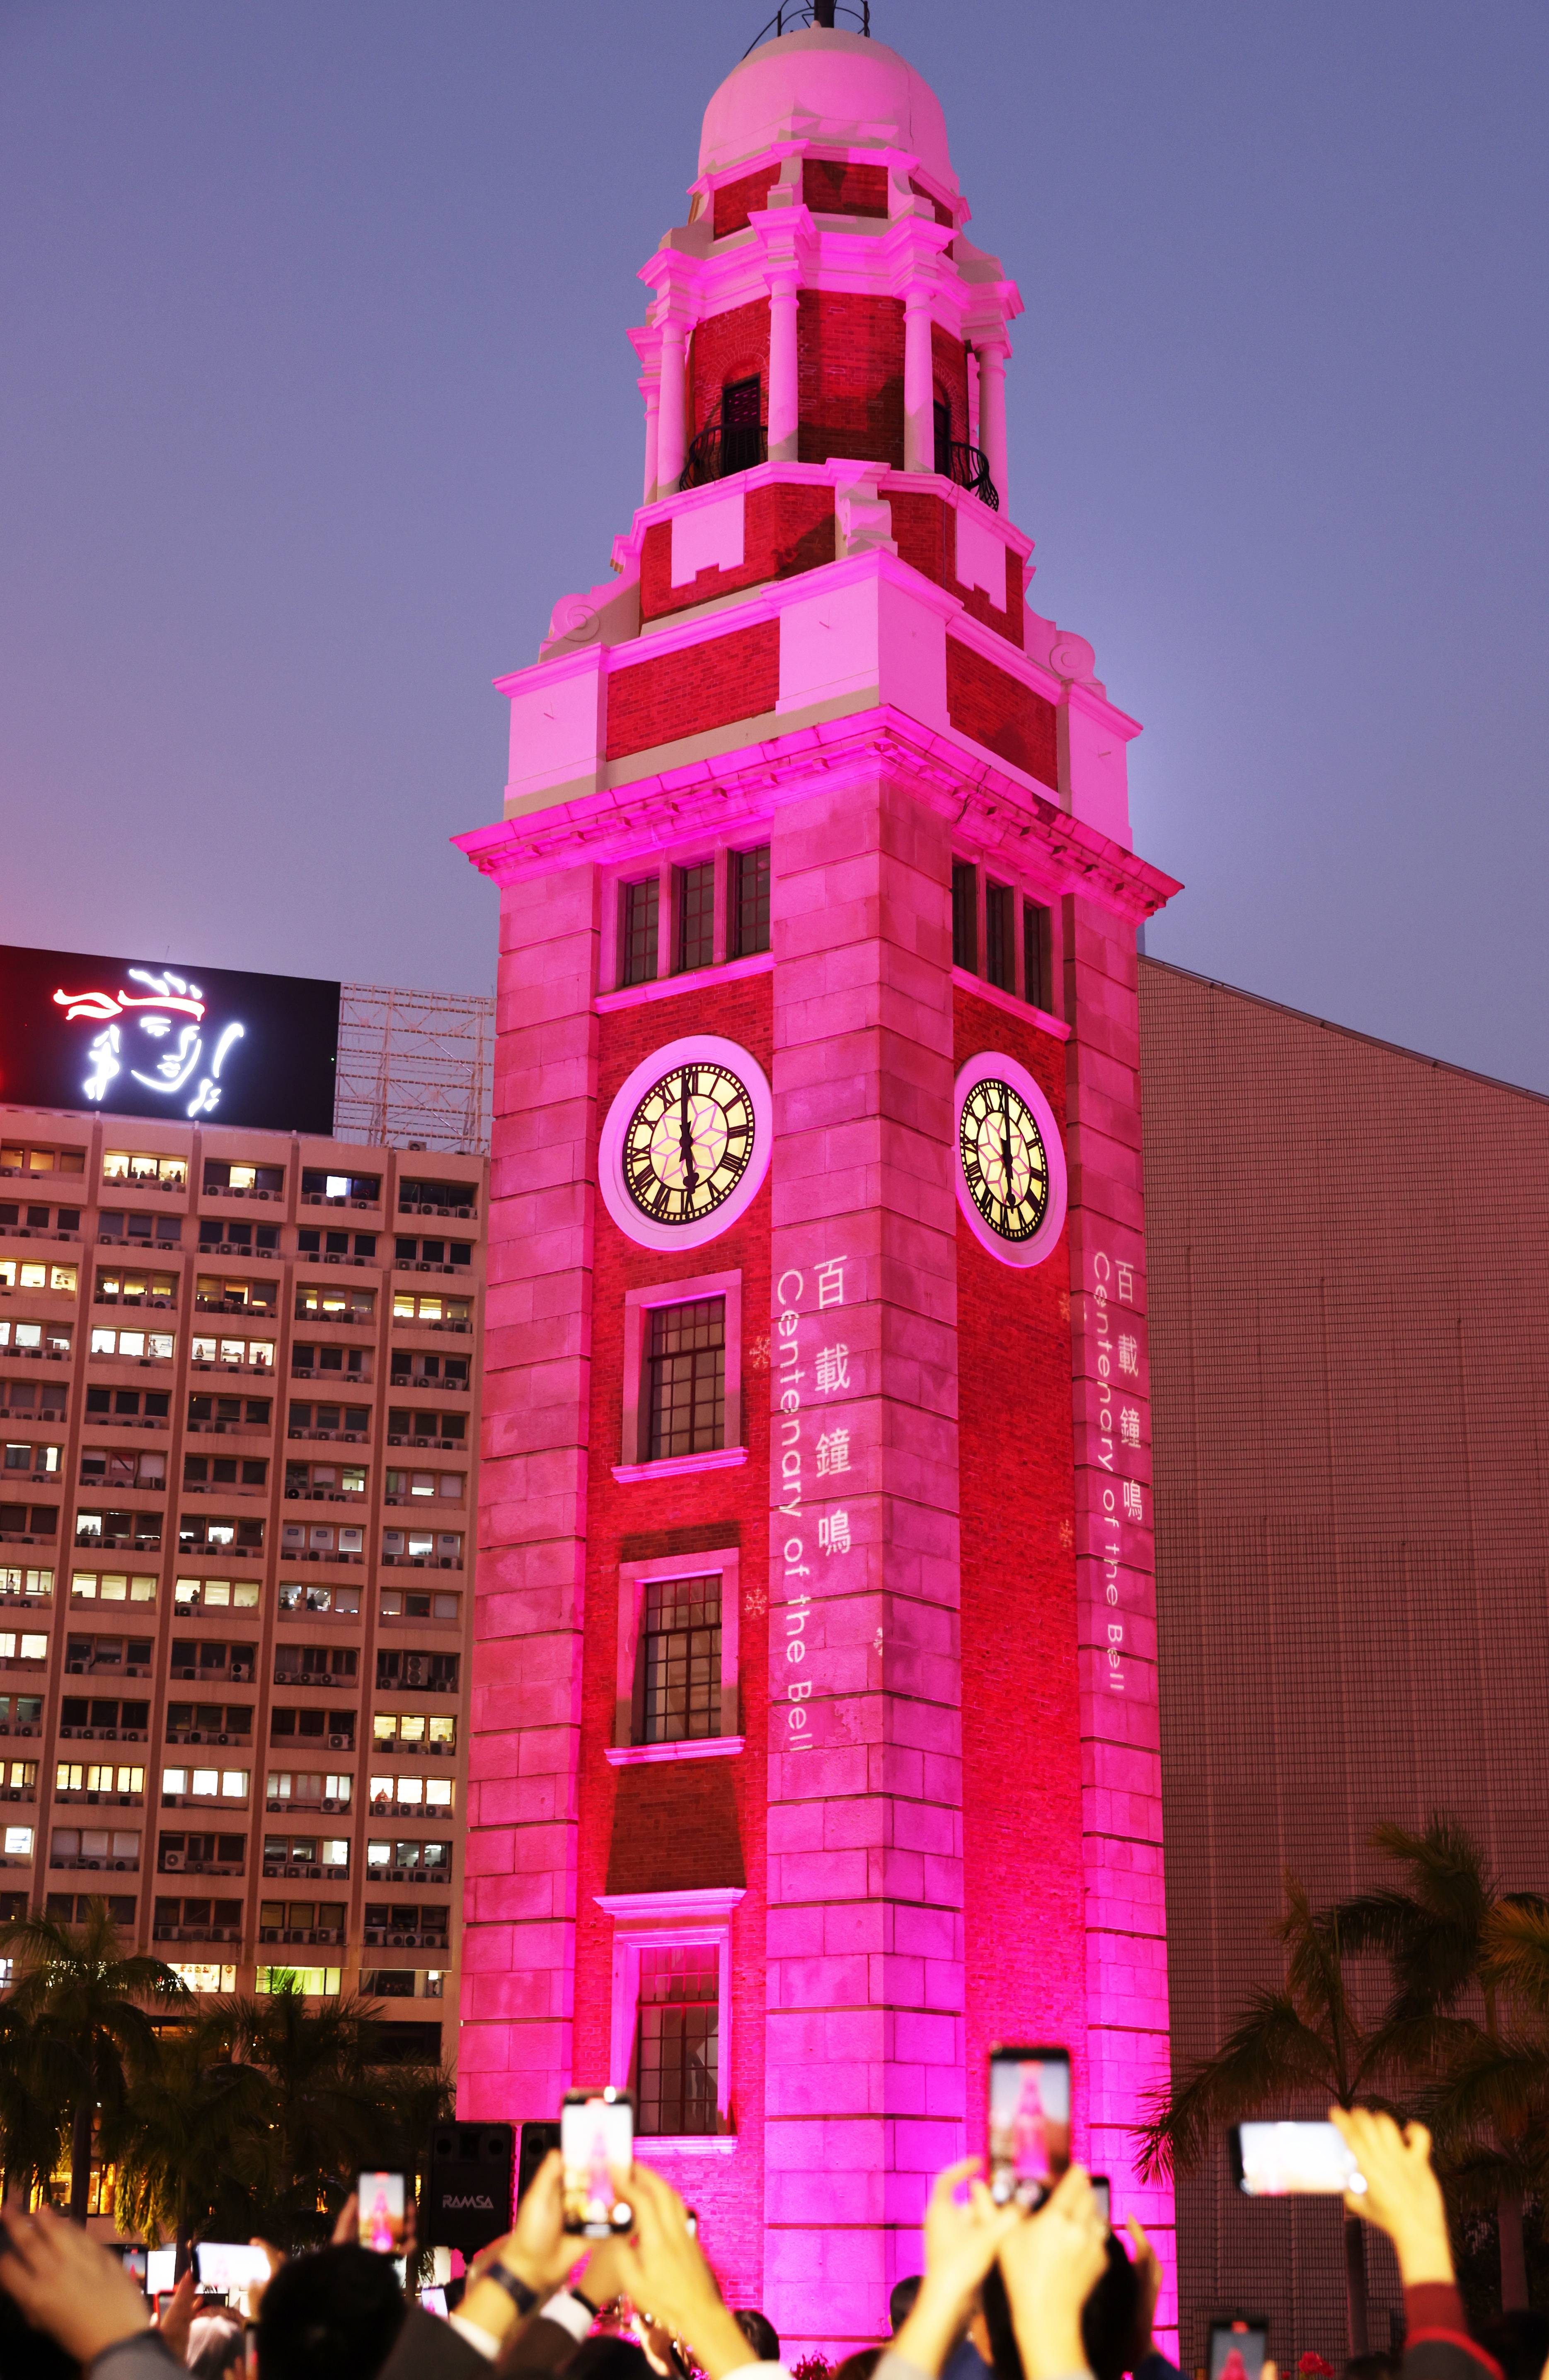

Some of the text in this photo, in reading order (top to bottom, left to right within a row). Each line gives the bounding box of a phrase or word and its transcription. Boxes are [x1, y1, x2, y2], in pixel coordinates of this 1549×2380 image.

[656, 1083, 675, 1111] XI
[980, 1090, 994, 1115] XI
[639, 1114, 659, 1131] X
[632, 1143, 651, 1163] IX
[1115, 1259, 1142, 1521] 百載鐘鳴
[814, 1255, 851, 1556] 百載鐘鳴
[1093, 1252, 1124, 1691] Centenary of the Bell
[777, 1269, 813, 1752] Centenary of the Bell
[443, 2195, 494, 2208] RAMSA
